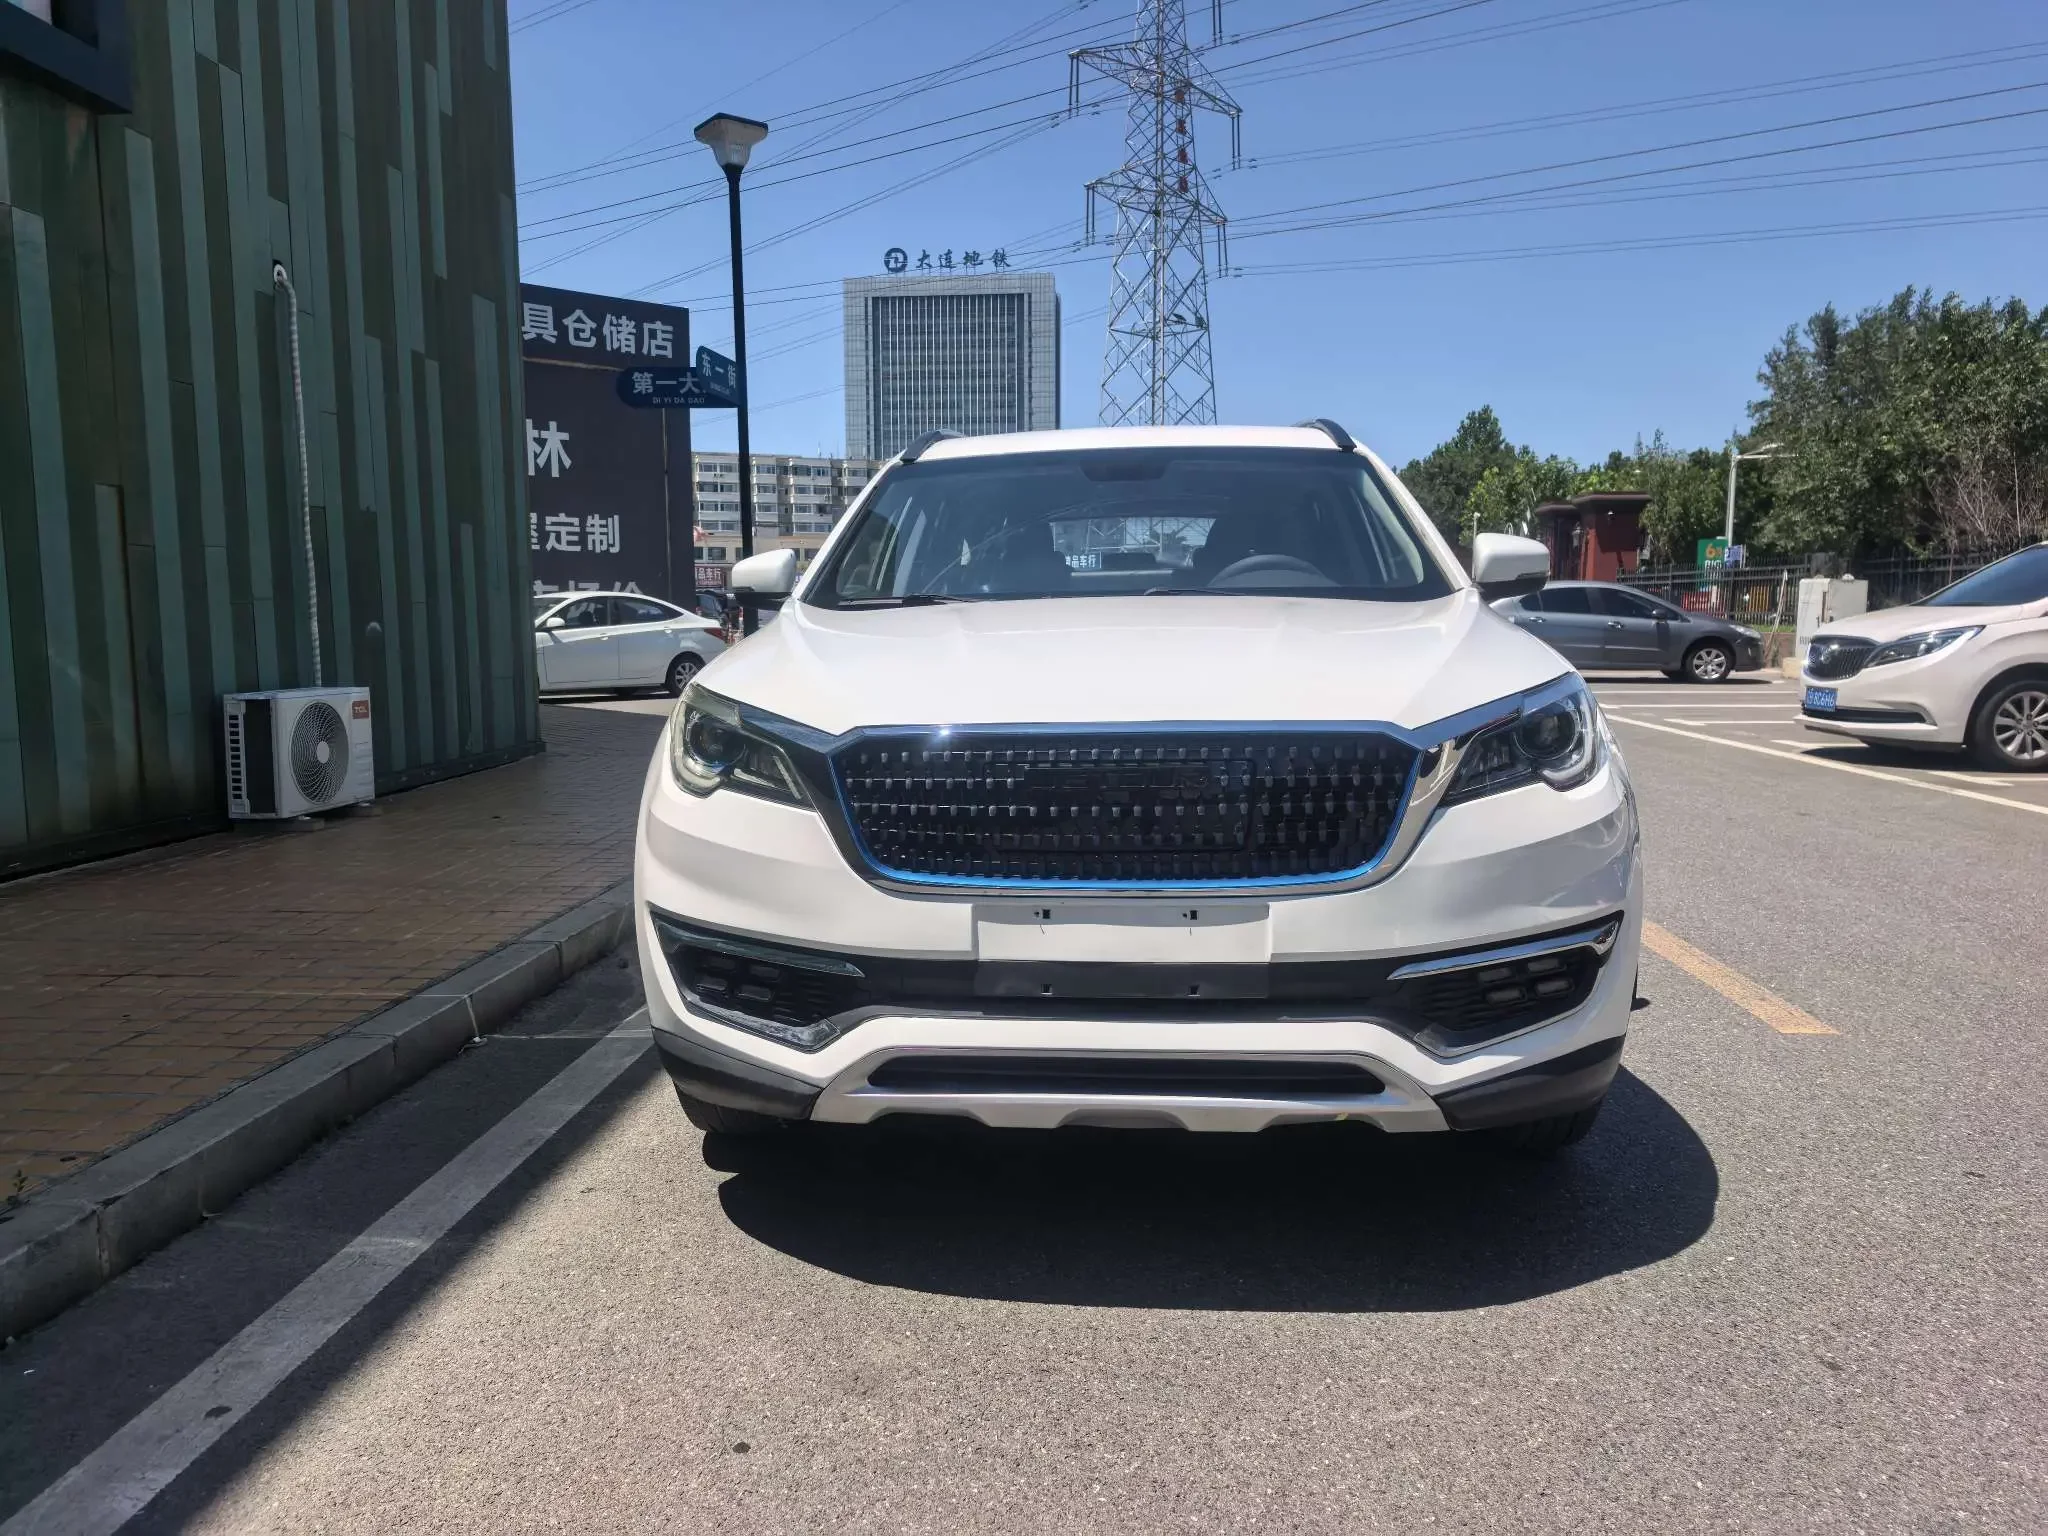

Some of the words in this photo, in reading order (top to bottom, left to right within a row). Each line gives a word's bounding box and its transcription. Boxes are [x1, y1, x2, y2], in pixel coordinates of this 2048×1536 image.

[521, 302, 674, 359] 具仓储店
[631, 371, 706, 395] 第一大
[701, 352, 737, 389] 东一街
[530, 512, 621, 554] 定制
[695, 566, 721, 581] 品车行
